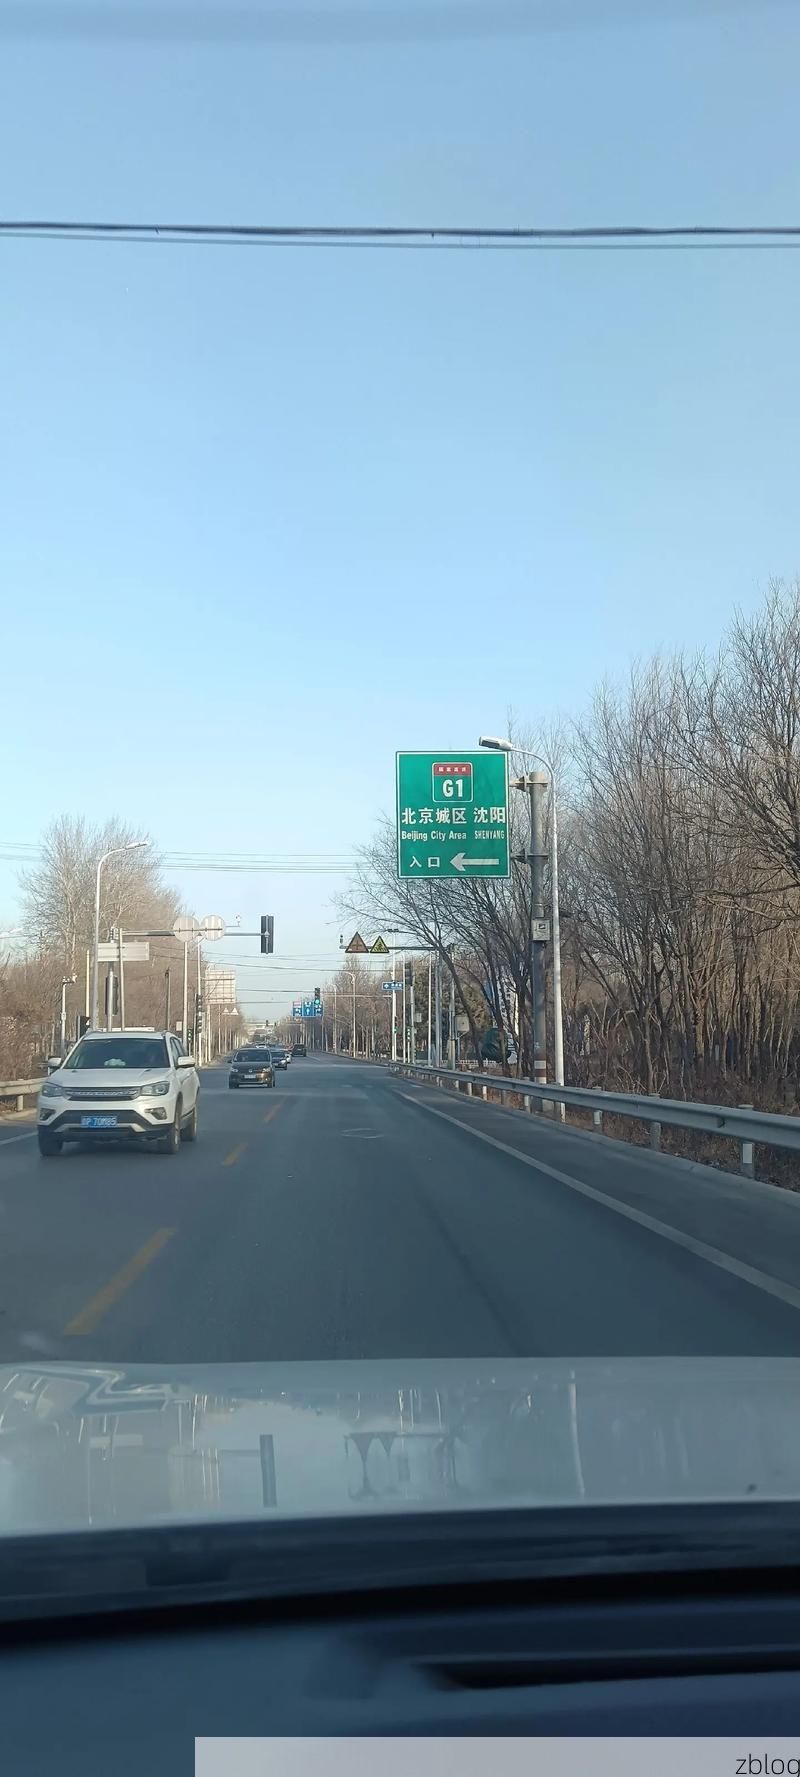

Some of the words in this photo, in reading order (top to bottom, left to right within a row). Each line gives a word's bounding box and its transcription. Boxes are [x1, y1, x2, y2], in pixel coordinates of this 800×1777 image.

[443, 779, 463, 797] G1
[401, 807, 467, 824] 北京城区
[473, 807, 505, 824] 沈阳
[401, 831, 427, 842] Beijing
[430, 831, 446, 841] City
[449, 831, 466, 839] Area
[474, 830, 505, 839] SHENYANG
[409, 856, 440, 868] 入口
